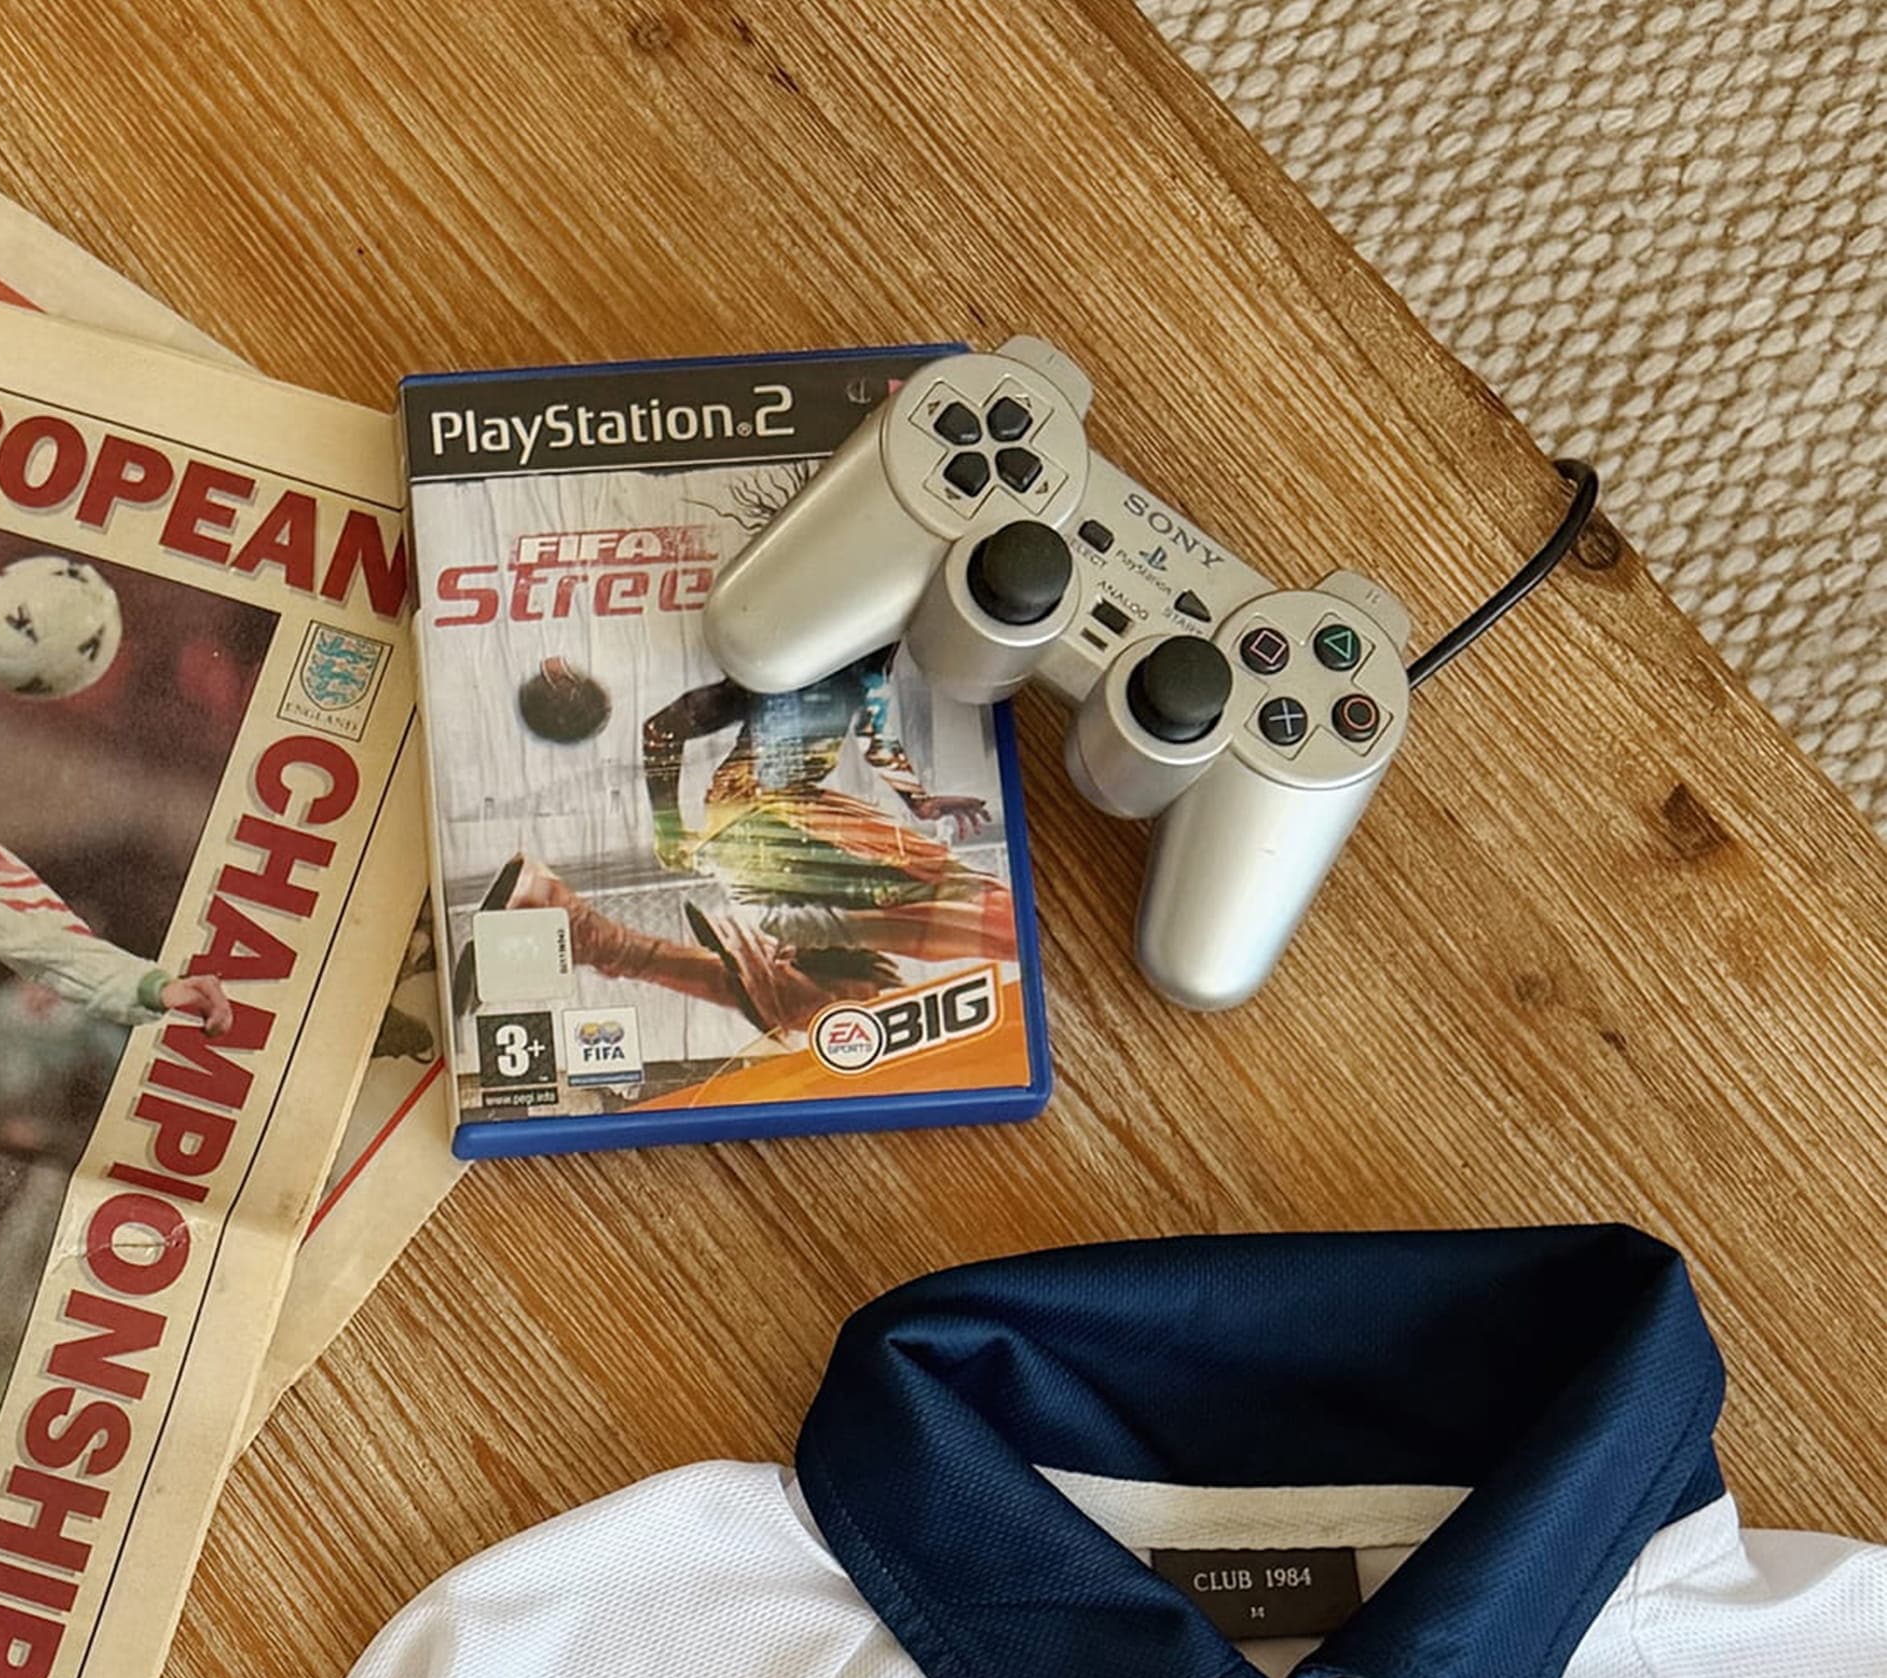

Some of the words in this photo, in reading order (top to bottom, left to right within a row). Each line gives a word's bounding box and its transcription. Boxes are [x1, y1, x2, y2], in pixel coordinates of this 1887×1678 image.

[517, 530, 664, 564] FIFA
[1123, 493, 1225, 570] SONY
[1066, 535, 1107, 567] ELECT
[433, 562, 714, 628] Stree
[1097, 579, 1149, 621] ANALOG
[828, 1021, 872, 1044] EA
[874, 977, 990, 1056] BIG
[583, 1046, 626, 1062] FIFA
[827, 1042, 874, 1055] SPORTS
[1192, 1570, 1254, 1592] CLUB
[1264, 1567, 1313, 1588] 1984
